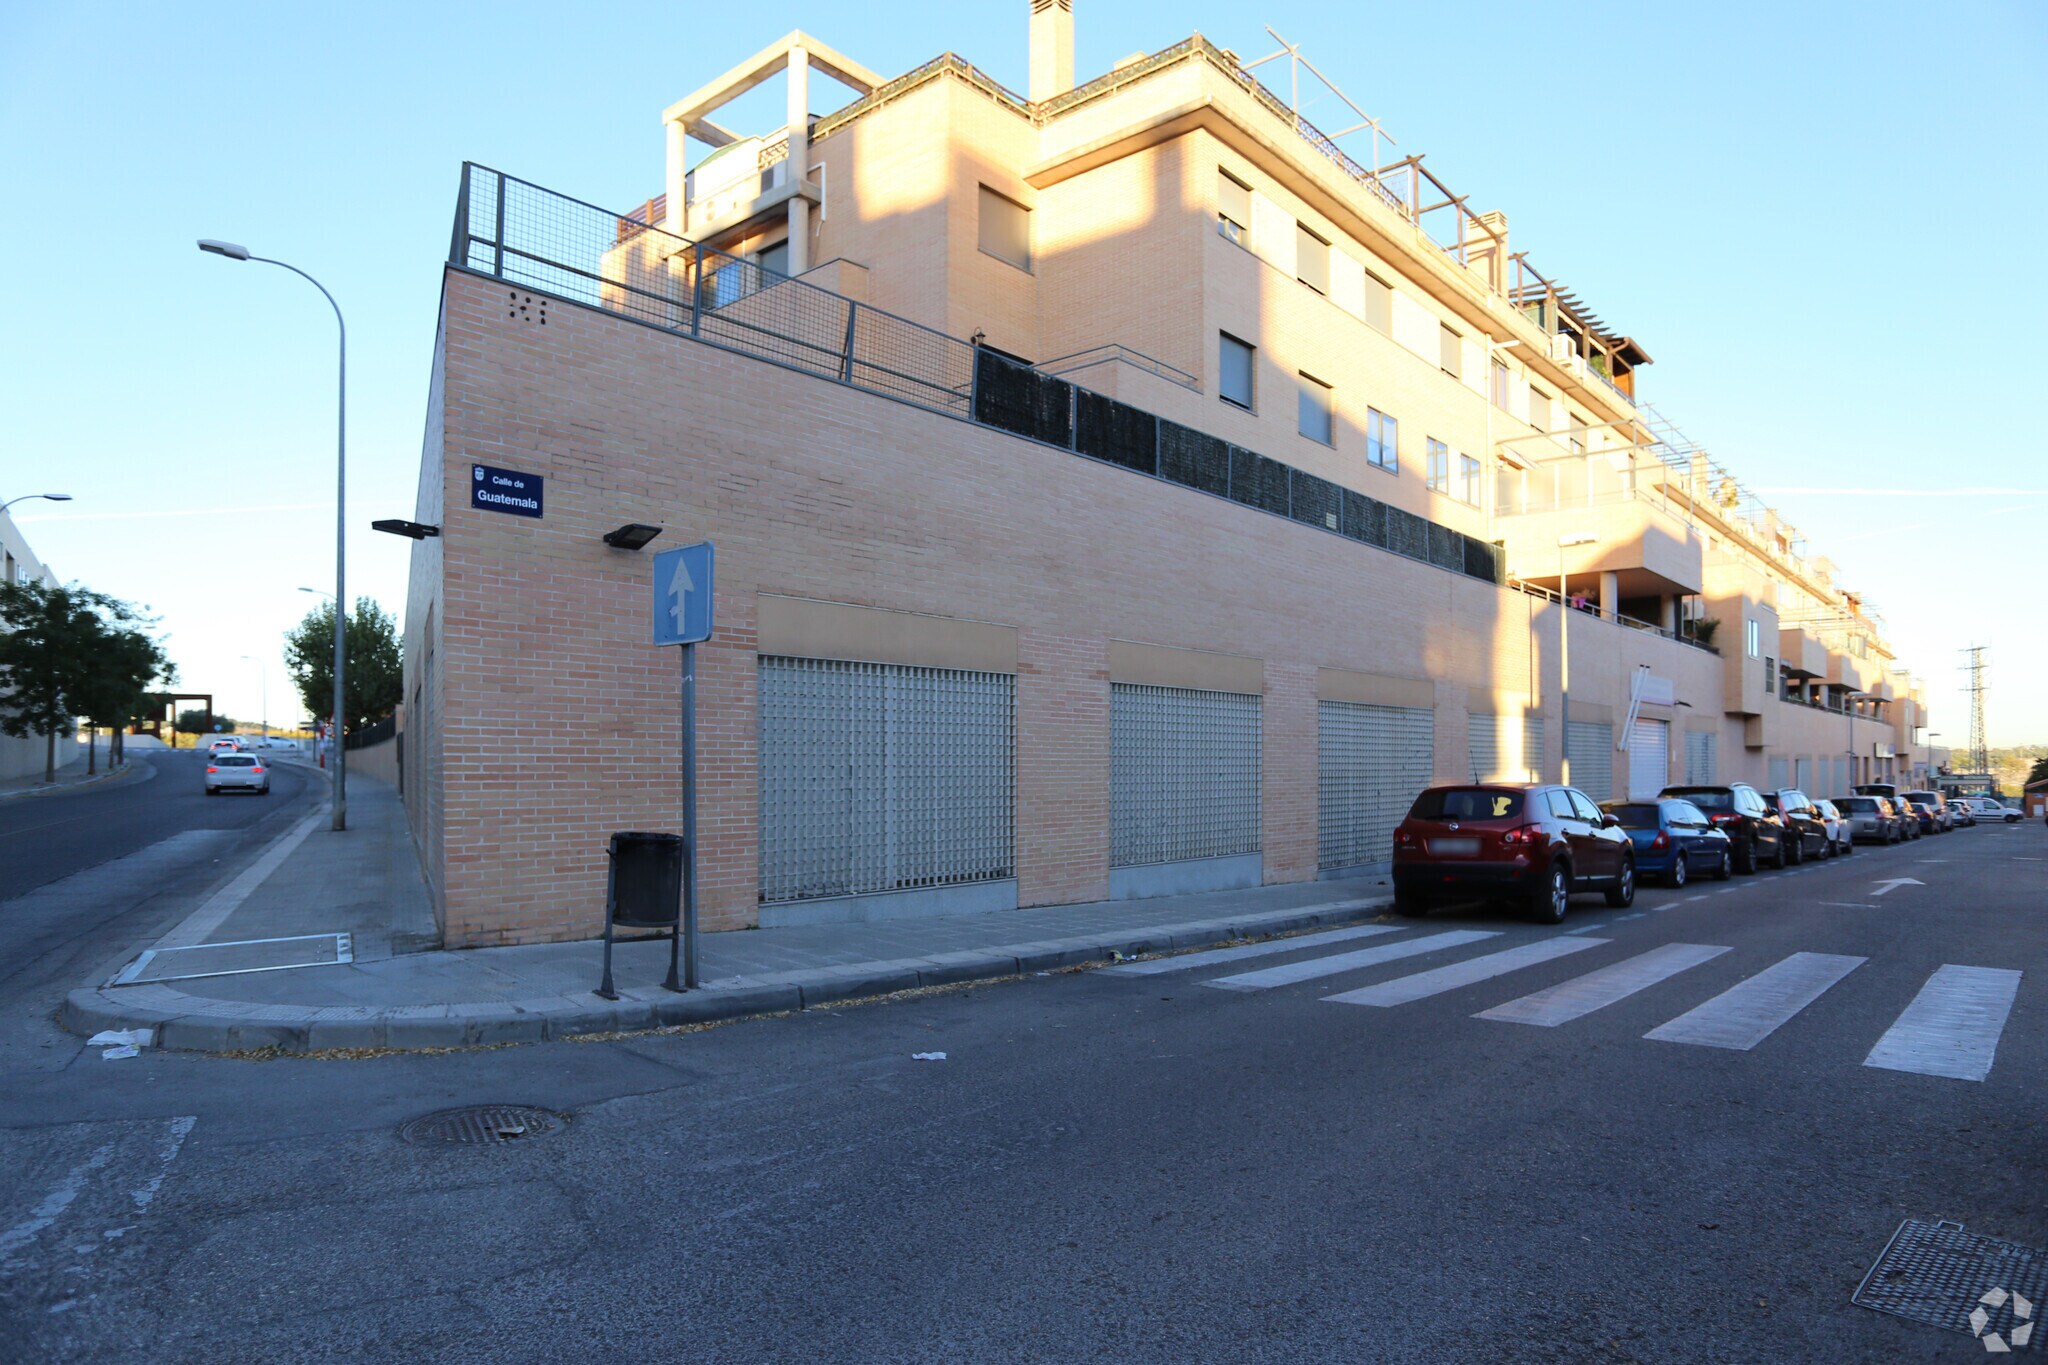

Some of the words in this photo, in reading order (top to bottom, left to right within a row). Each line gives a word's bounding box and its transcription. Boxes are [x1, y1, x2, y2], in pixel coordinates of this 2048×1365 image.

[492, 476, 512, 486] Calle
[514, 480, 524, 488] de
[477, 489, 538, 509] Guatemala
